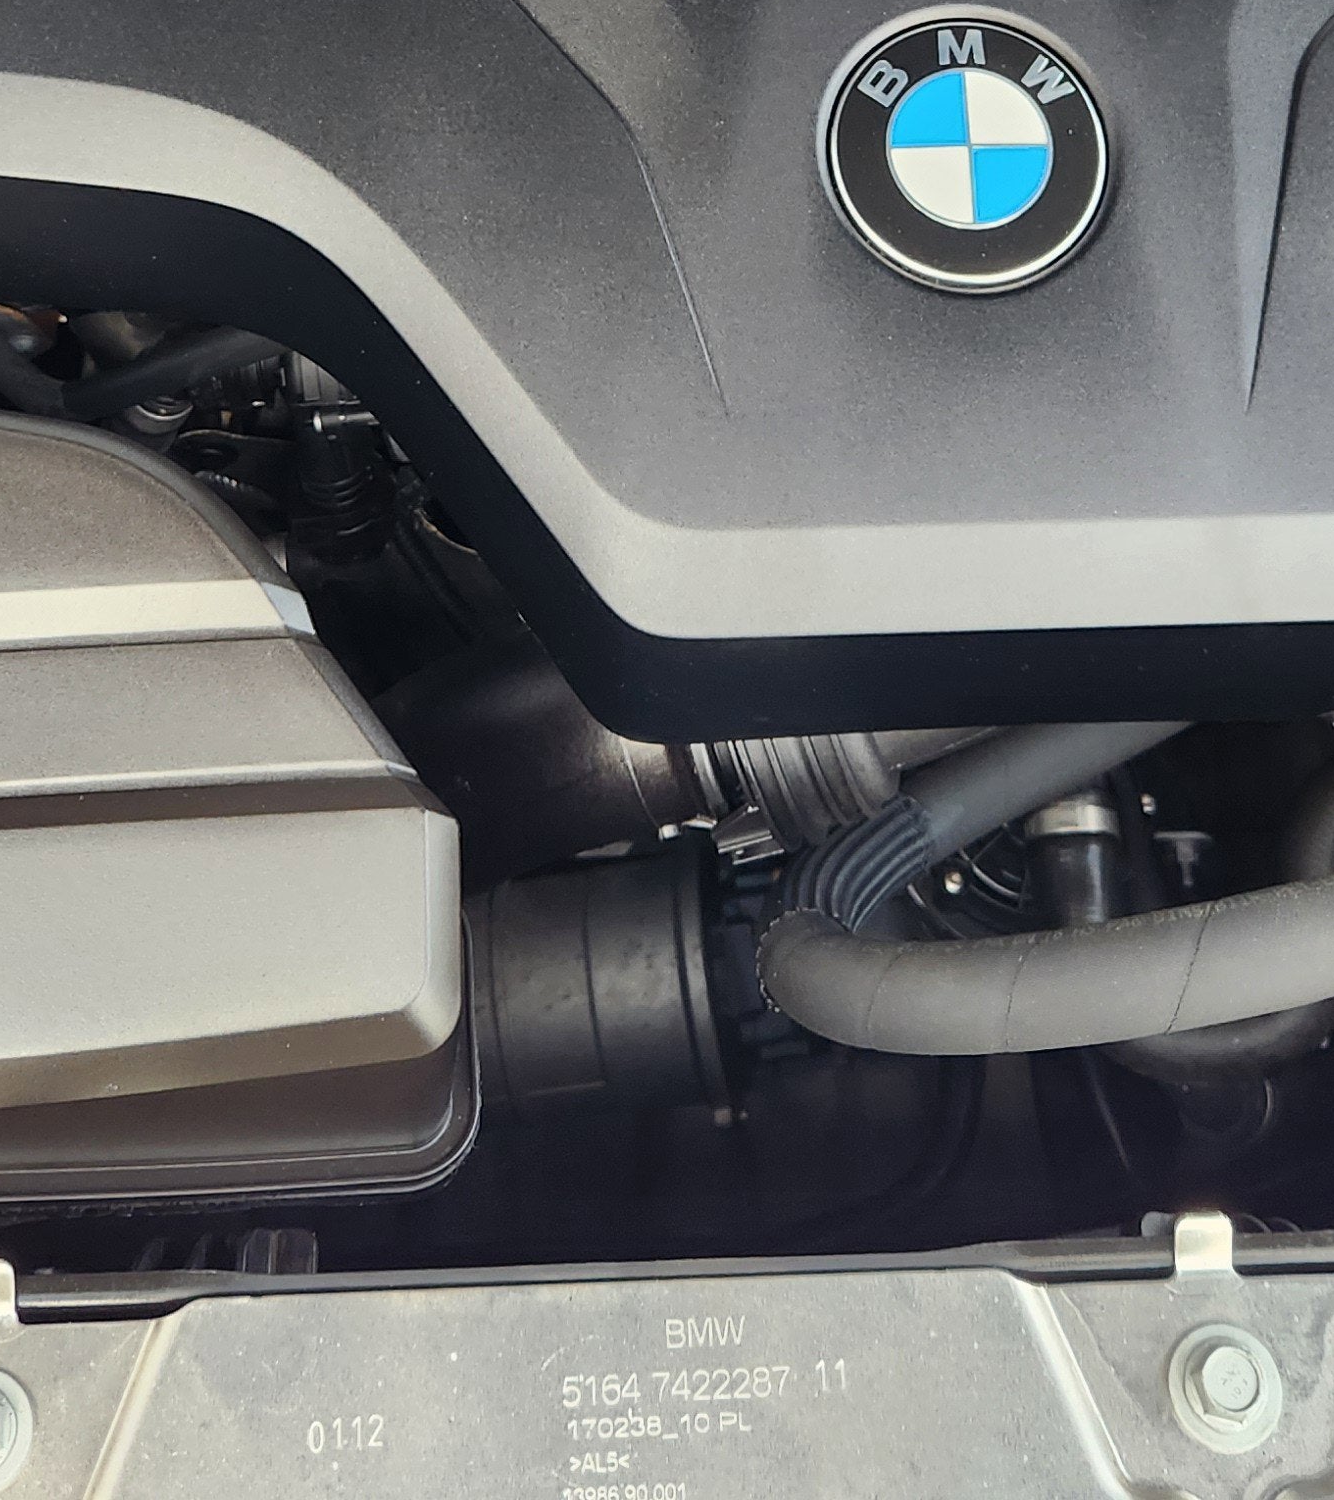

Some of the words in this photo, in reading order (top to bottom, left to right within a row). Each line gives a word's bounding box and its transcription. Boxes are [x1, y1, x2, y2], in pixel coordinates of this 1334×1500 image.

[857, 28, 1075, 108] BMW
[665, 1316, 745, 1349] BMW
[562, 1372, 641, 1408] 5164
[651, 1366, 790, 1402] 7422287
[815, 1358, 846, 1398] 11
[719, 1411, 752, 1432] PL
